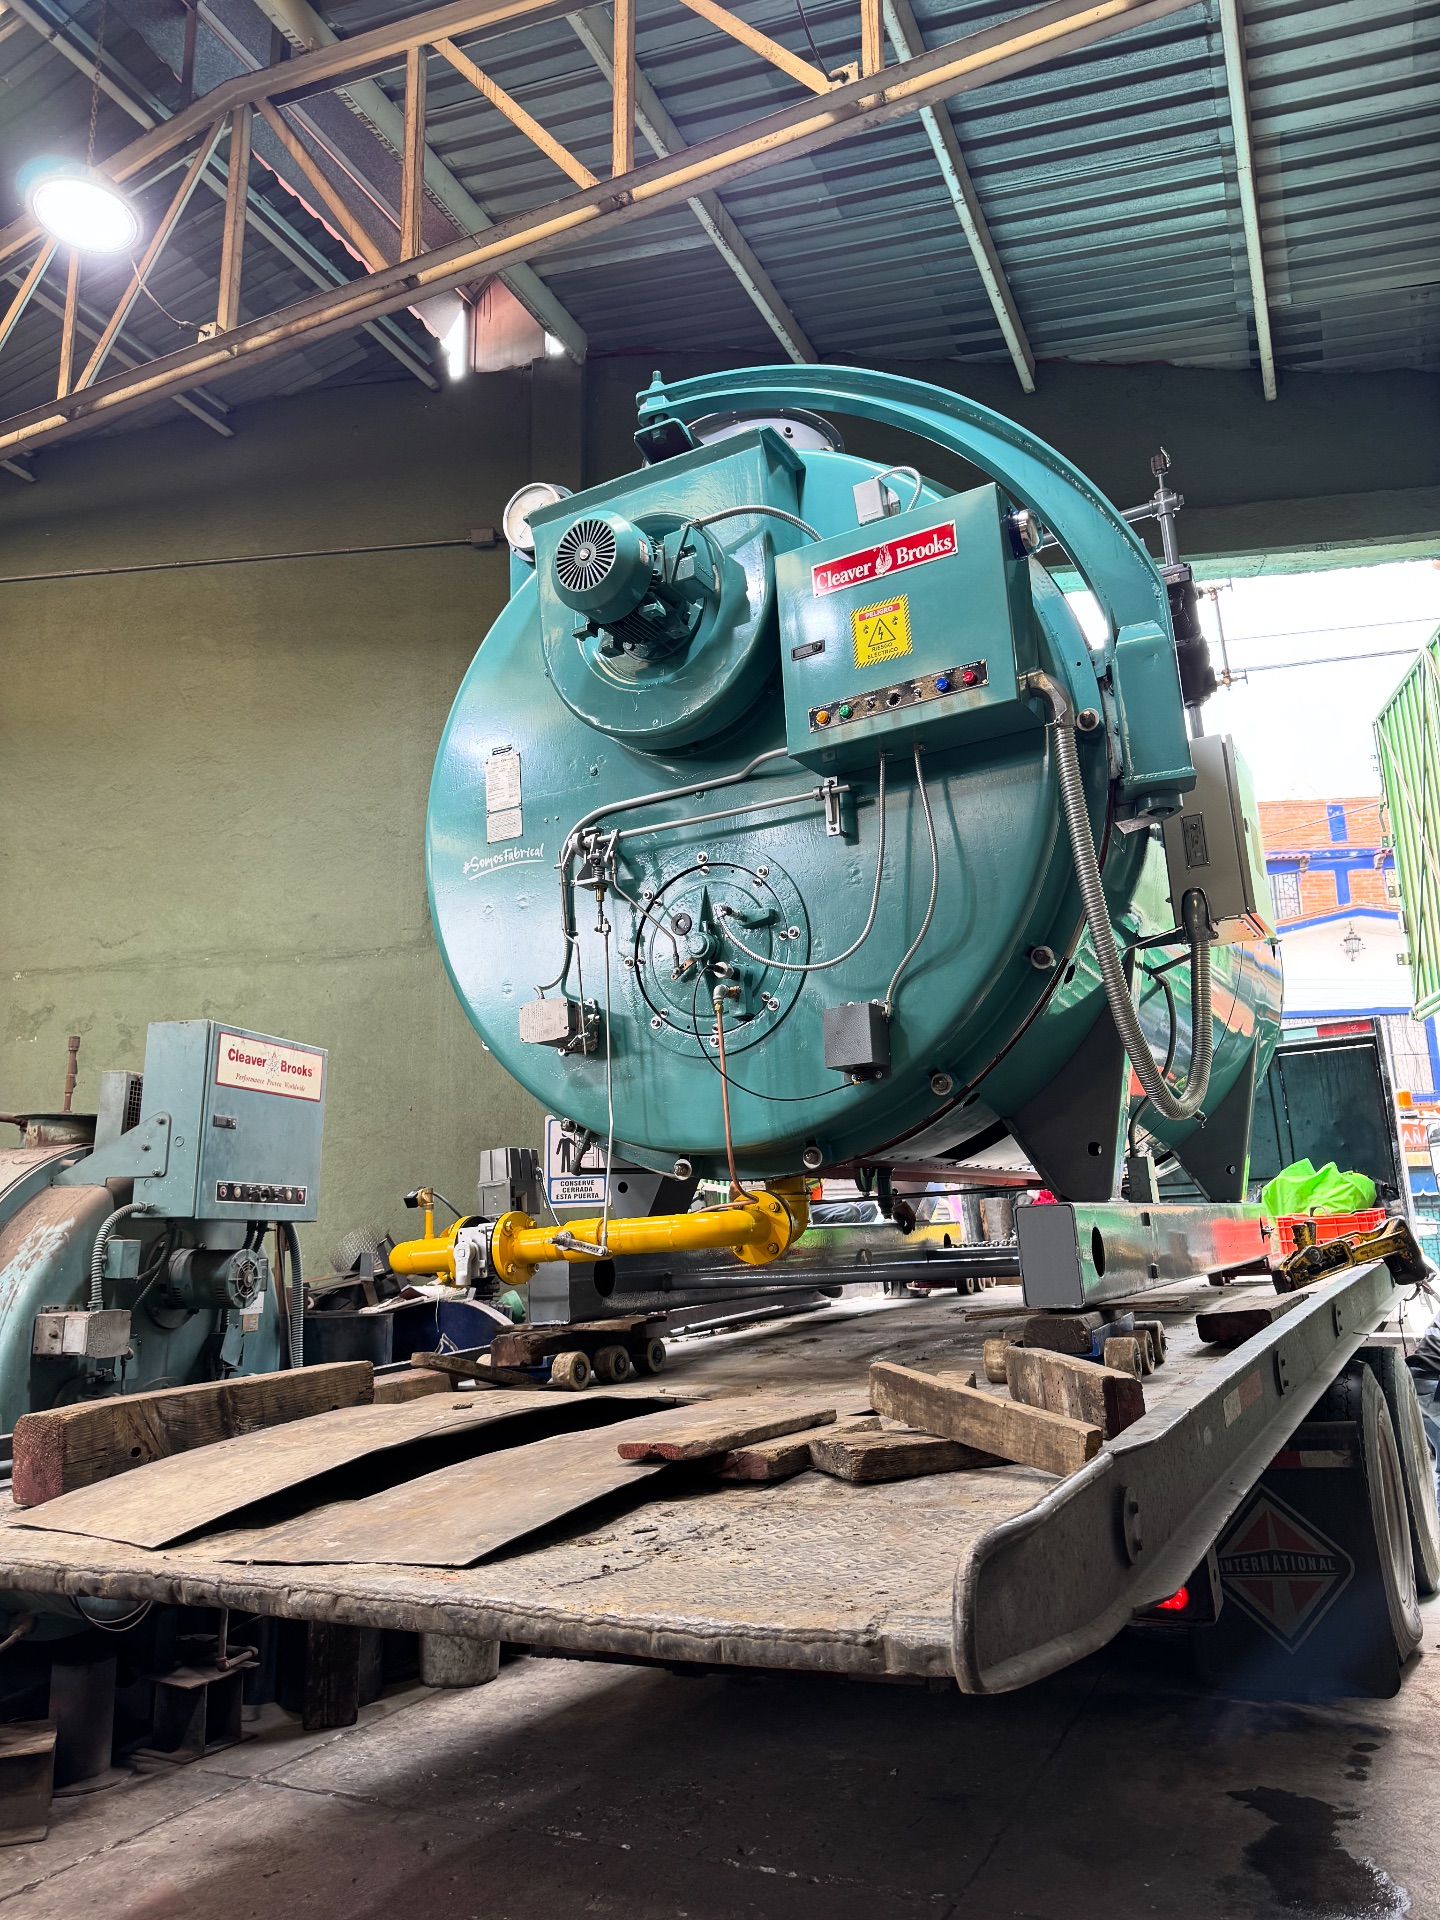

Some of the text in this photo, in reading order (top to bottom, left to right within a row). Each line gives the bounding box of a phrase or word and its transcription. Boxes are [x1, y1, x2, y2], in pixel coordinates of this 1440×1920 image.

[816, 534, 953, 590] Cleaver Brooks
[865, 605, 894, 619] PELIGRO
[871, 642, 893, 652] RIESGO
[227, 1047, 313, 1077] Cleaver Brooks
[235, 1072, 306, 1092] Performance Proven Worldwide
[1219, 1554, 1336, 1572] INTERNATIONAL
